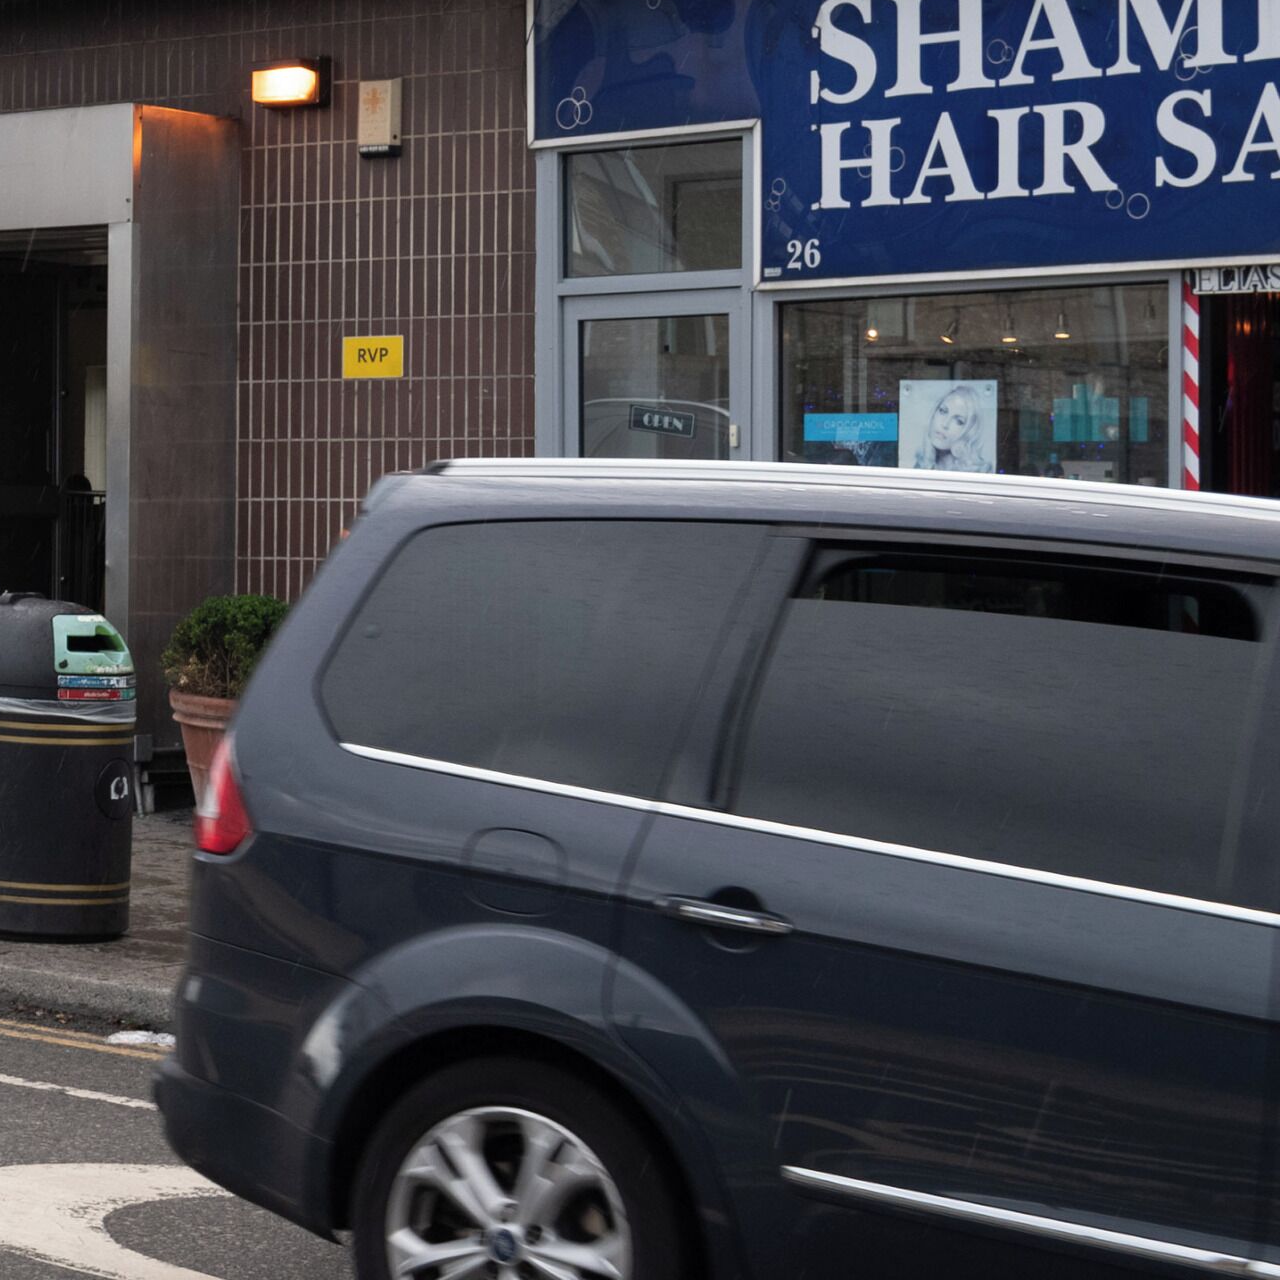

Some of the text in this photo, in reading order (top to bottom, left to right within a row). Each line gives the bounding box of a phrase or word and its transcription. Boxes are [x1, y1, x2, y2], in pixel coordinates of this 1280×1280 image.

[811, 101, 1119, 211] HAIR
[786, 238, 821, 271] 26
[357, 347, 389, 363] RVP
[643, 412, 683, 431] OPEN
